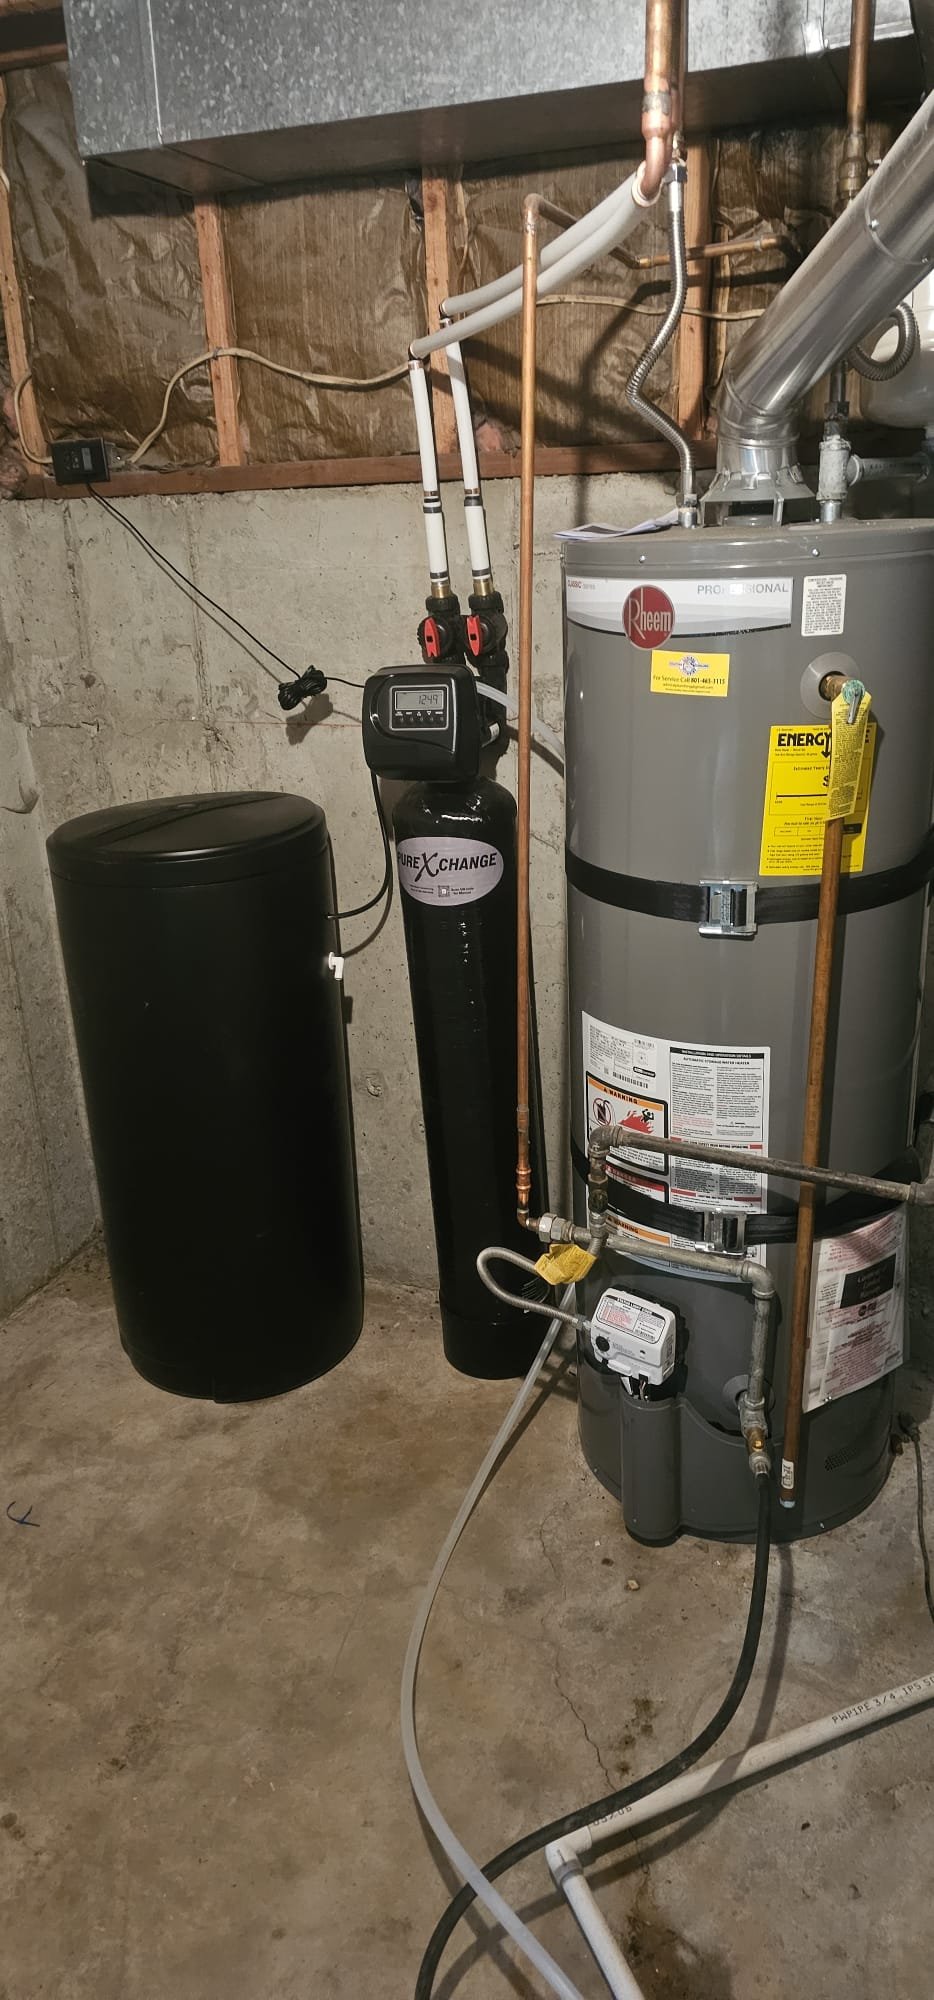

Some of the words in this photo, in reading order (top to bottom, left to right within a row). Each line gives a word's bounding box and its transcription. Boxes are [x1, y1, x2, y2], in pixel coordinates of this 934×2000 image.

[628, 587, 672, 641] Rheem
[777, 732, 832, 747] ENERGY
[609, 1089, 638, 1105] WARNING
[831, 1702, 872, 1724] PWPIPE
[872, 1693, 896, 1707] 3/4
[902, 1683, 922, 1695] IPS
